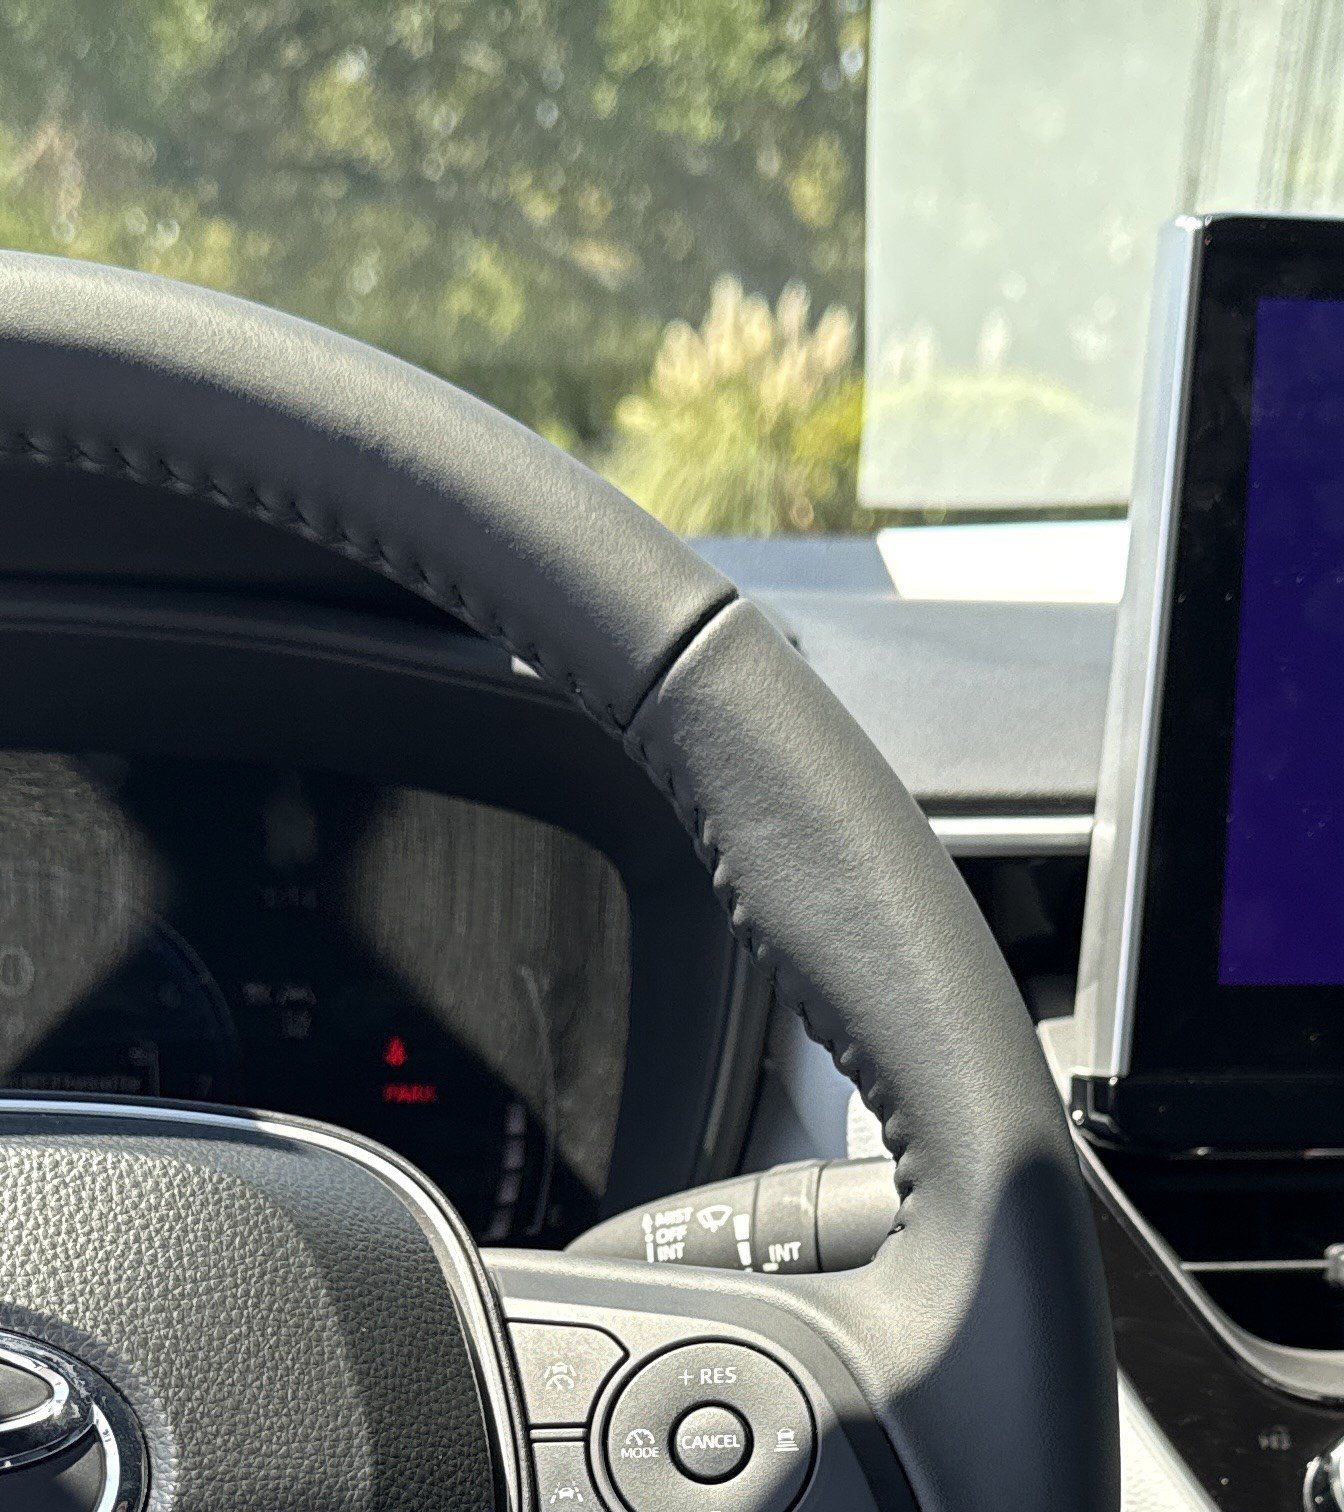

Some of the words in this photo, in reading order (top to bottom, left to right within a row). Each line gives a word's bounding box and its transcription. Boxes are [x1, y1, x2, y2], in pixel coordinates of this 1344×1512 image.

[656, 1224, 687, 1245] OFF
[657, 1242, 686, 1262] INT
[768, 1241, 802, 1263] INT
[700, 1366, 738, 1385] RES
[680, 1433, 742, 1450] CANCEL
[620, 1446, 660, 1460] MODE
